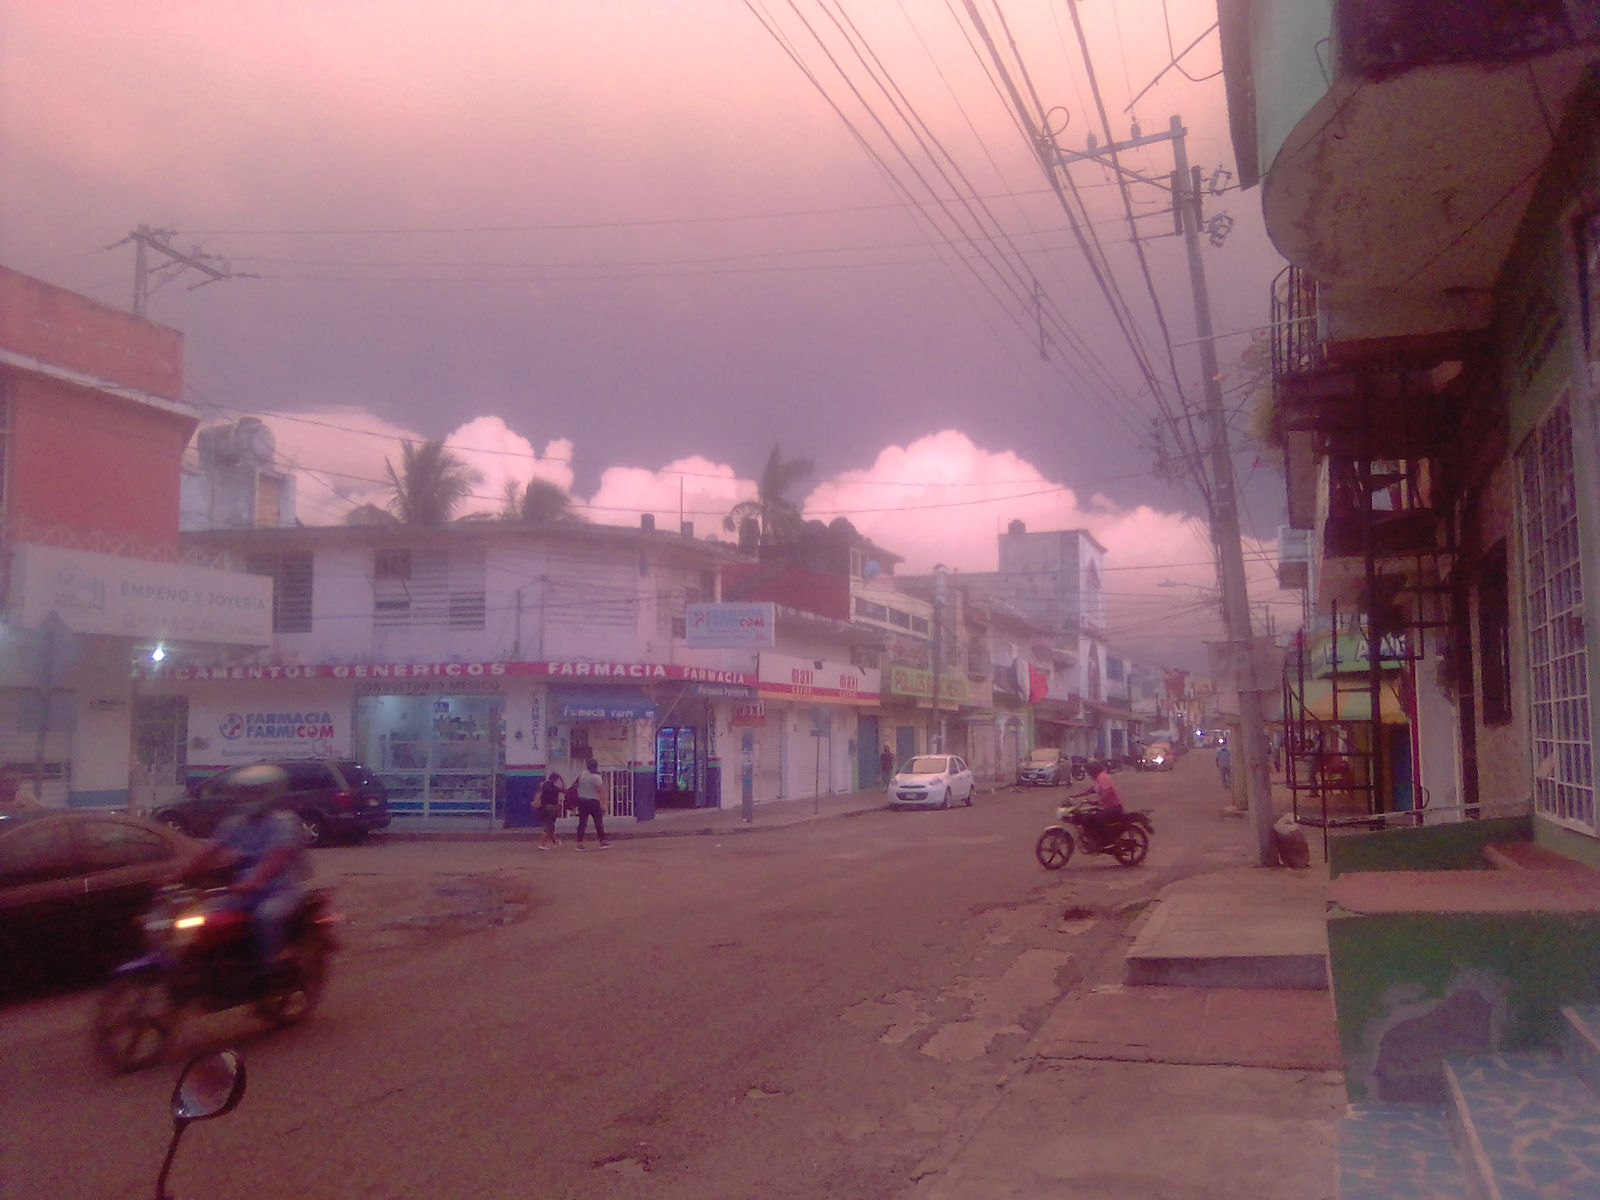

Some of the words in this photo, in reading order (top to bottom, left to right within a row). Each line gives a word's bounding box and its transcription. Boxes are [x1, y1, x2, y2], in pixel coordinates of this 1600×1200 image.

[131, 666, 321, 680] ICAMENTOS
[333, 663, 506, 678] GENERICOS
[548, 663, 667, 678] FARMACIA
[683, 668, 745, 685] FARMACIA
[246, 712, 332, 723] FARMACIA
[246, 725, 335, 738] FARMICOM
